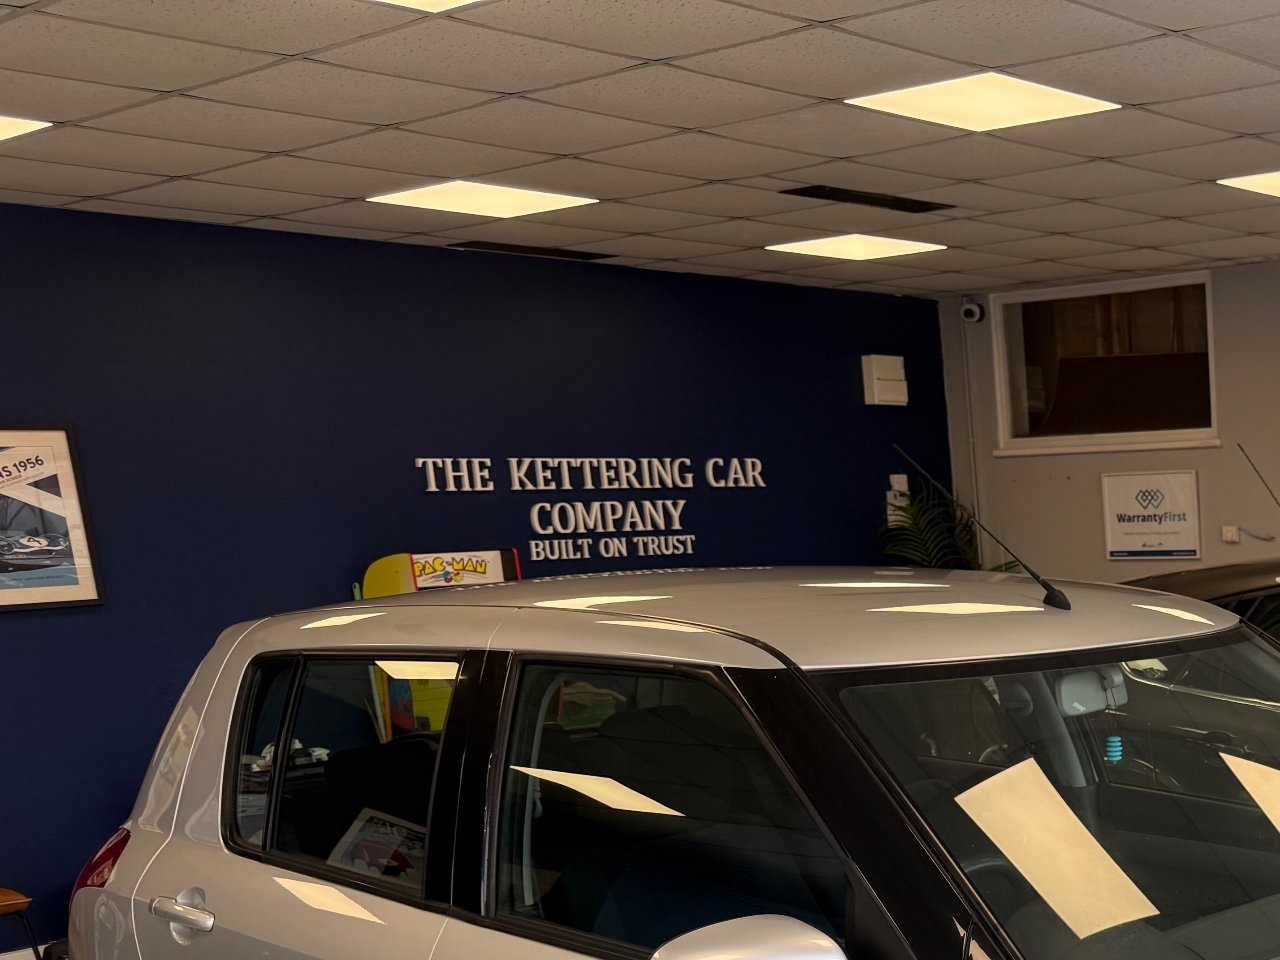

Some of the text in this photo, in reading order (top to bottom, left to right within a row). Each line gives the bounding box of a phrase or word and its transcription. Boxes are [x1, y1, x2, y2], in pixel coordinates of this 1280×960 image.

[0, 455, 44, 478] S 1956
[415, 457, 766, 492] THE KETTERING CAR
[530, 500, 686, 535] COMPANY
[1116, 512, 1187, 525] WarrantyFirst
[529, 535, 696, 561] BUILT ON TRUST
[414, 557, 487, 577] PAC-MAN
